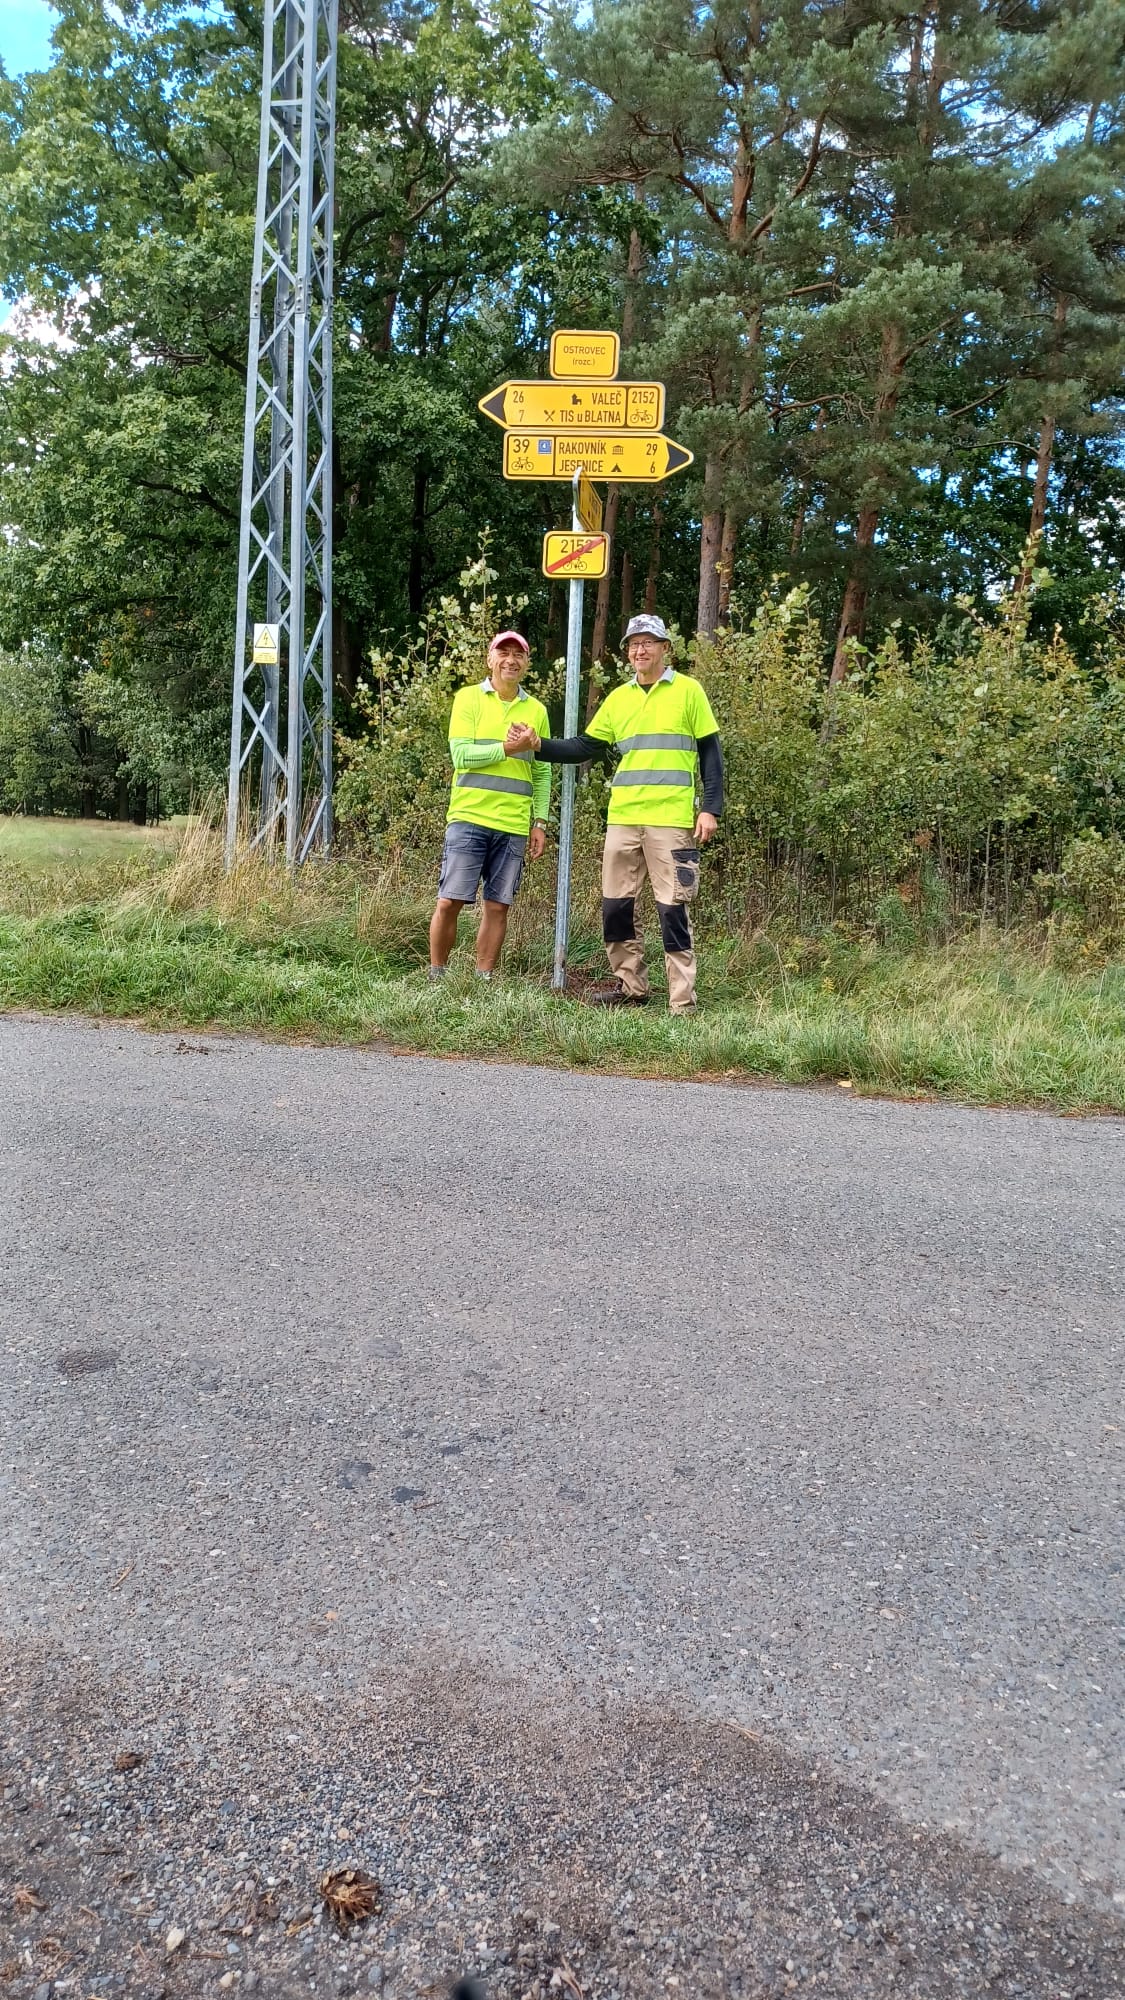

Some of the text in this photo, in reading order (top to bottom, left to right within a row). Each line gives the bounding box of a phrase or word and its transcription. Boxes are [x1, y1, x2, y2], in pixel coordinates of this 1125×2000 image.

[563, 345, 606, 355] OSTROVEC
[513, 390, 525, 403] 26
[591, 390, 622, 405] VALEČ
[631, 391, 655, 404] 2152
[519, 410, 525, 422] 7
[559, 410, 621, 423] TIS u BLATNA
[513, 439, 530, 453] 39
[559, 440, 607, 455] RAKOVNÍK
[646, 443, 658, 456] 29
[559, 459, 604, 473] JESENICE
[650, 461, 656, 474] 6
[560, 539, 593, 554] 2152
